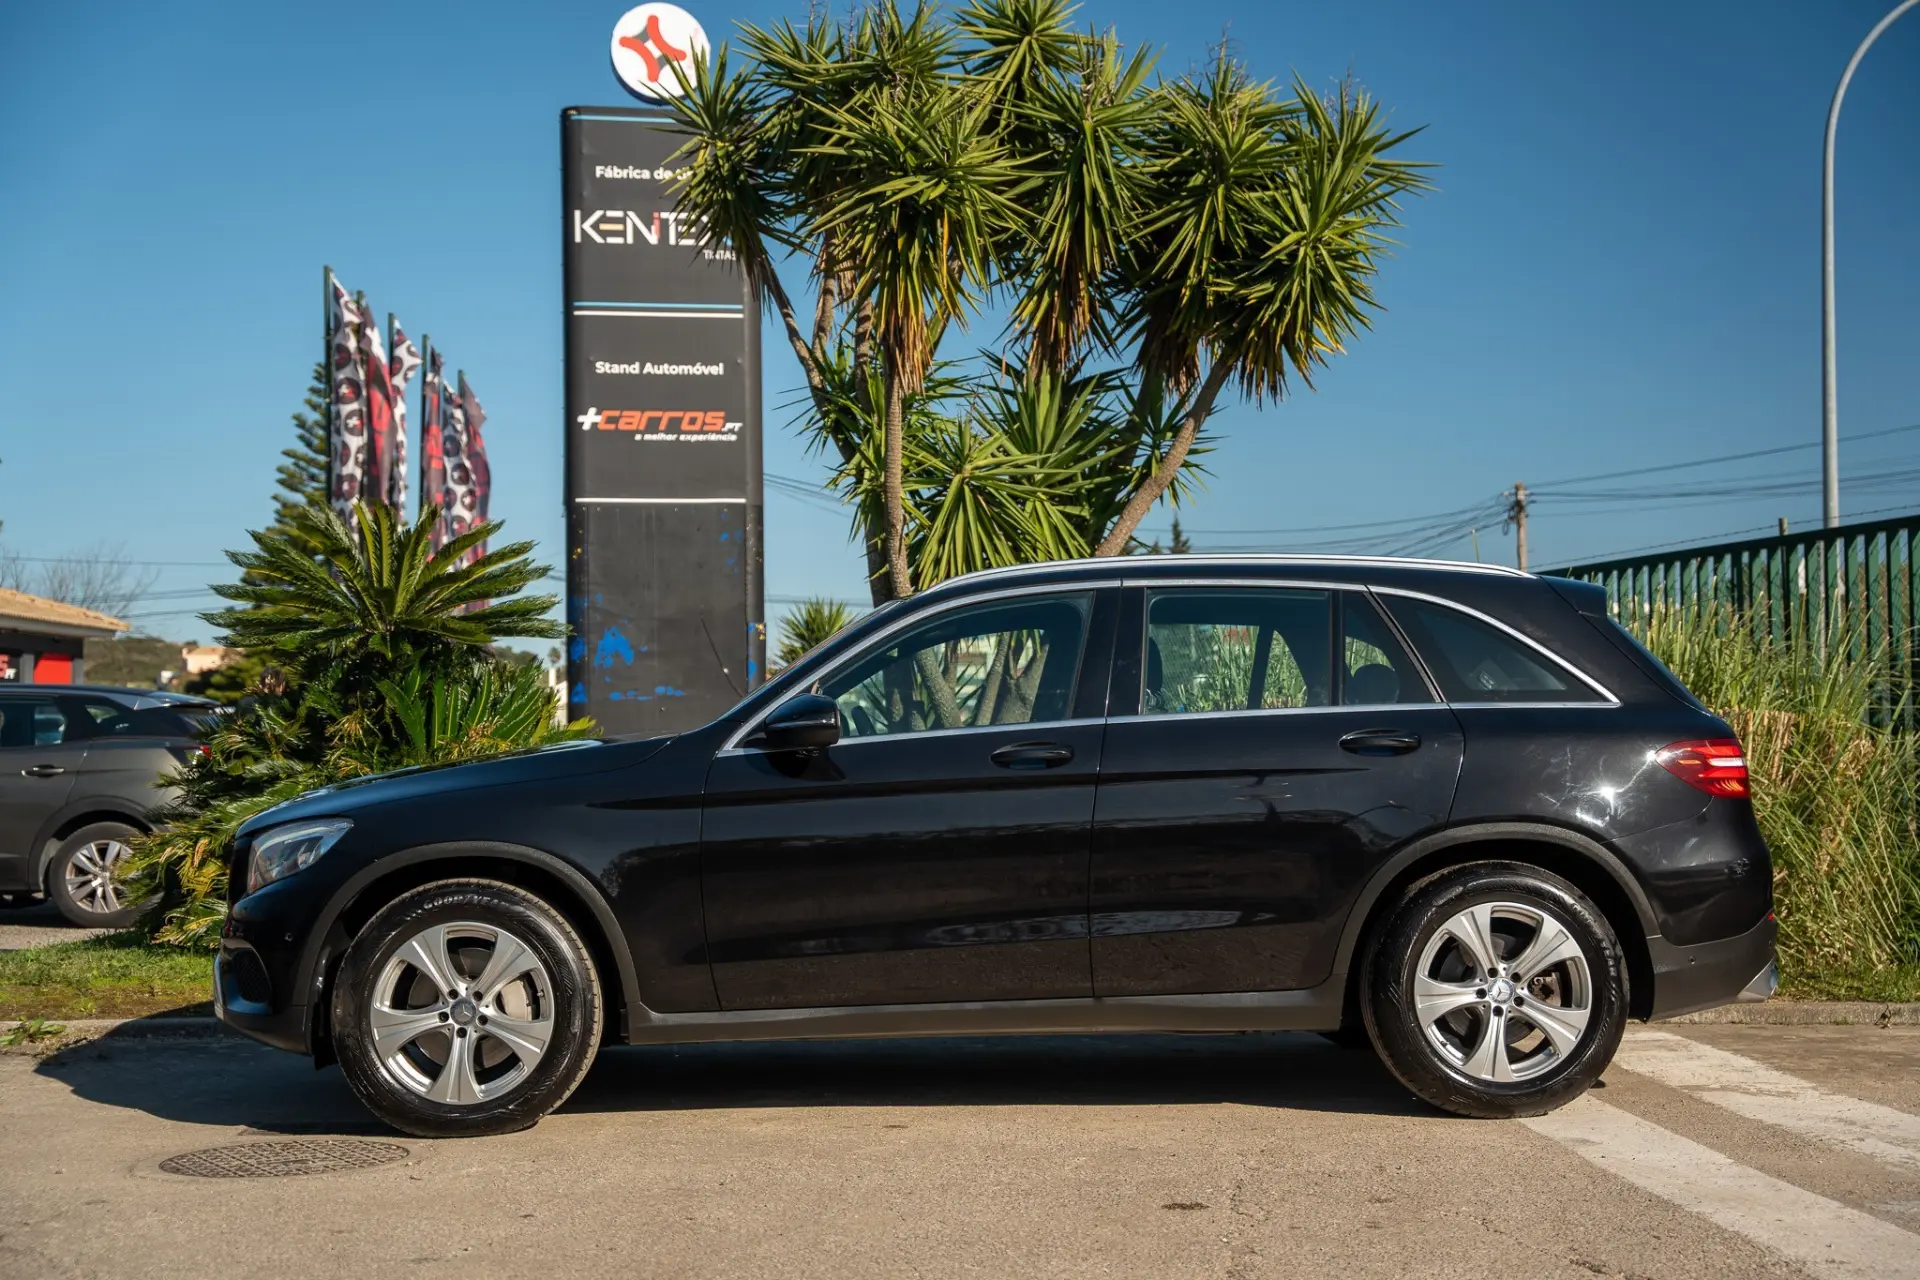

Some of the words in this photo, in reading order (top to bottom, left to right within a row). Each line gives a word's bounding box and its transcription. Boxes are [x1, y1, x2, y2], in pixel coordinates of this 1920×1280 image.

[595, 165, 650, 180] Fábrica
[653, 166, 673, 180] de
[595, 361, 639, 375] Stand
[642, 362, 725, 376] Automóvel
[643, 431, 678, 441] melhor
